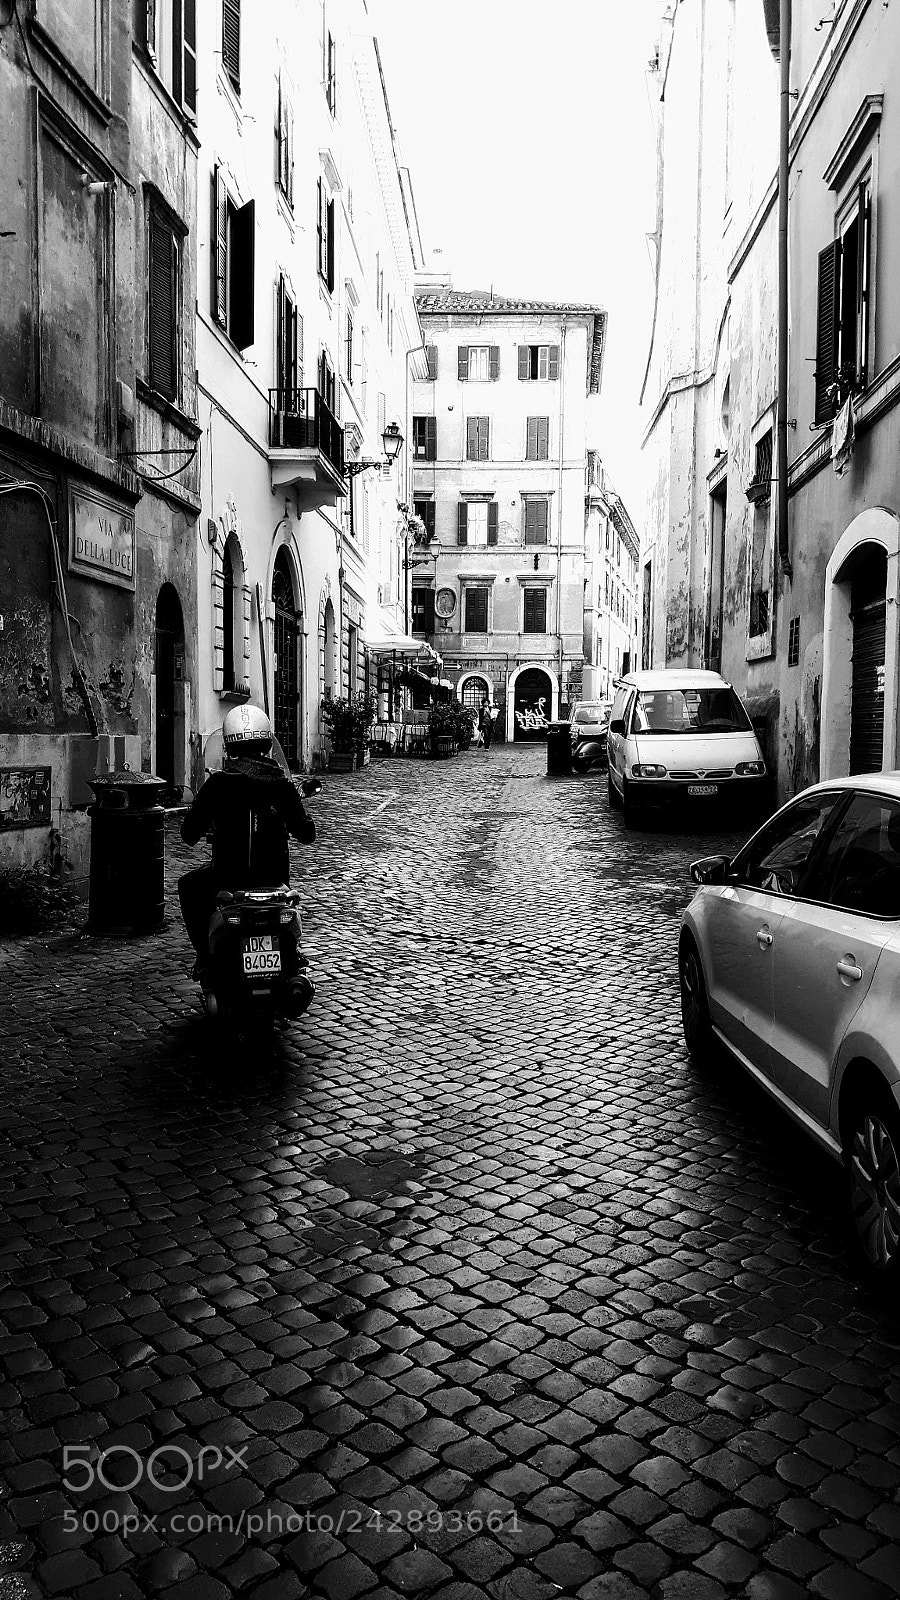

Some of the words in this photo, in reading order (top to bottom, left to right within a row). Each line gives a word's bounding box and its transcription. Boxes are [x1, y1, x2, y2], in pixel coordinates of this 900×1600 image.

[98, 516, 114, 538] VIA
[77, 536, 105, 562] DELLA
[109, 548, 131, 571] LUCE
[251, 937, 265, 951] DK
[245, 953, 280, 970] 84052
